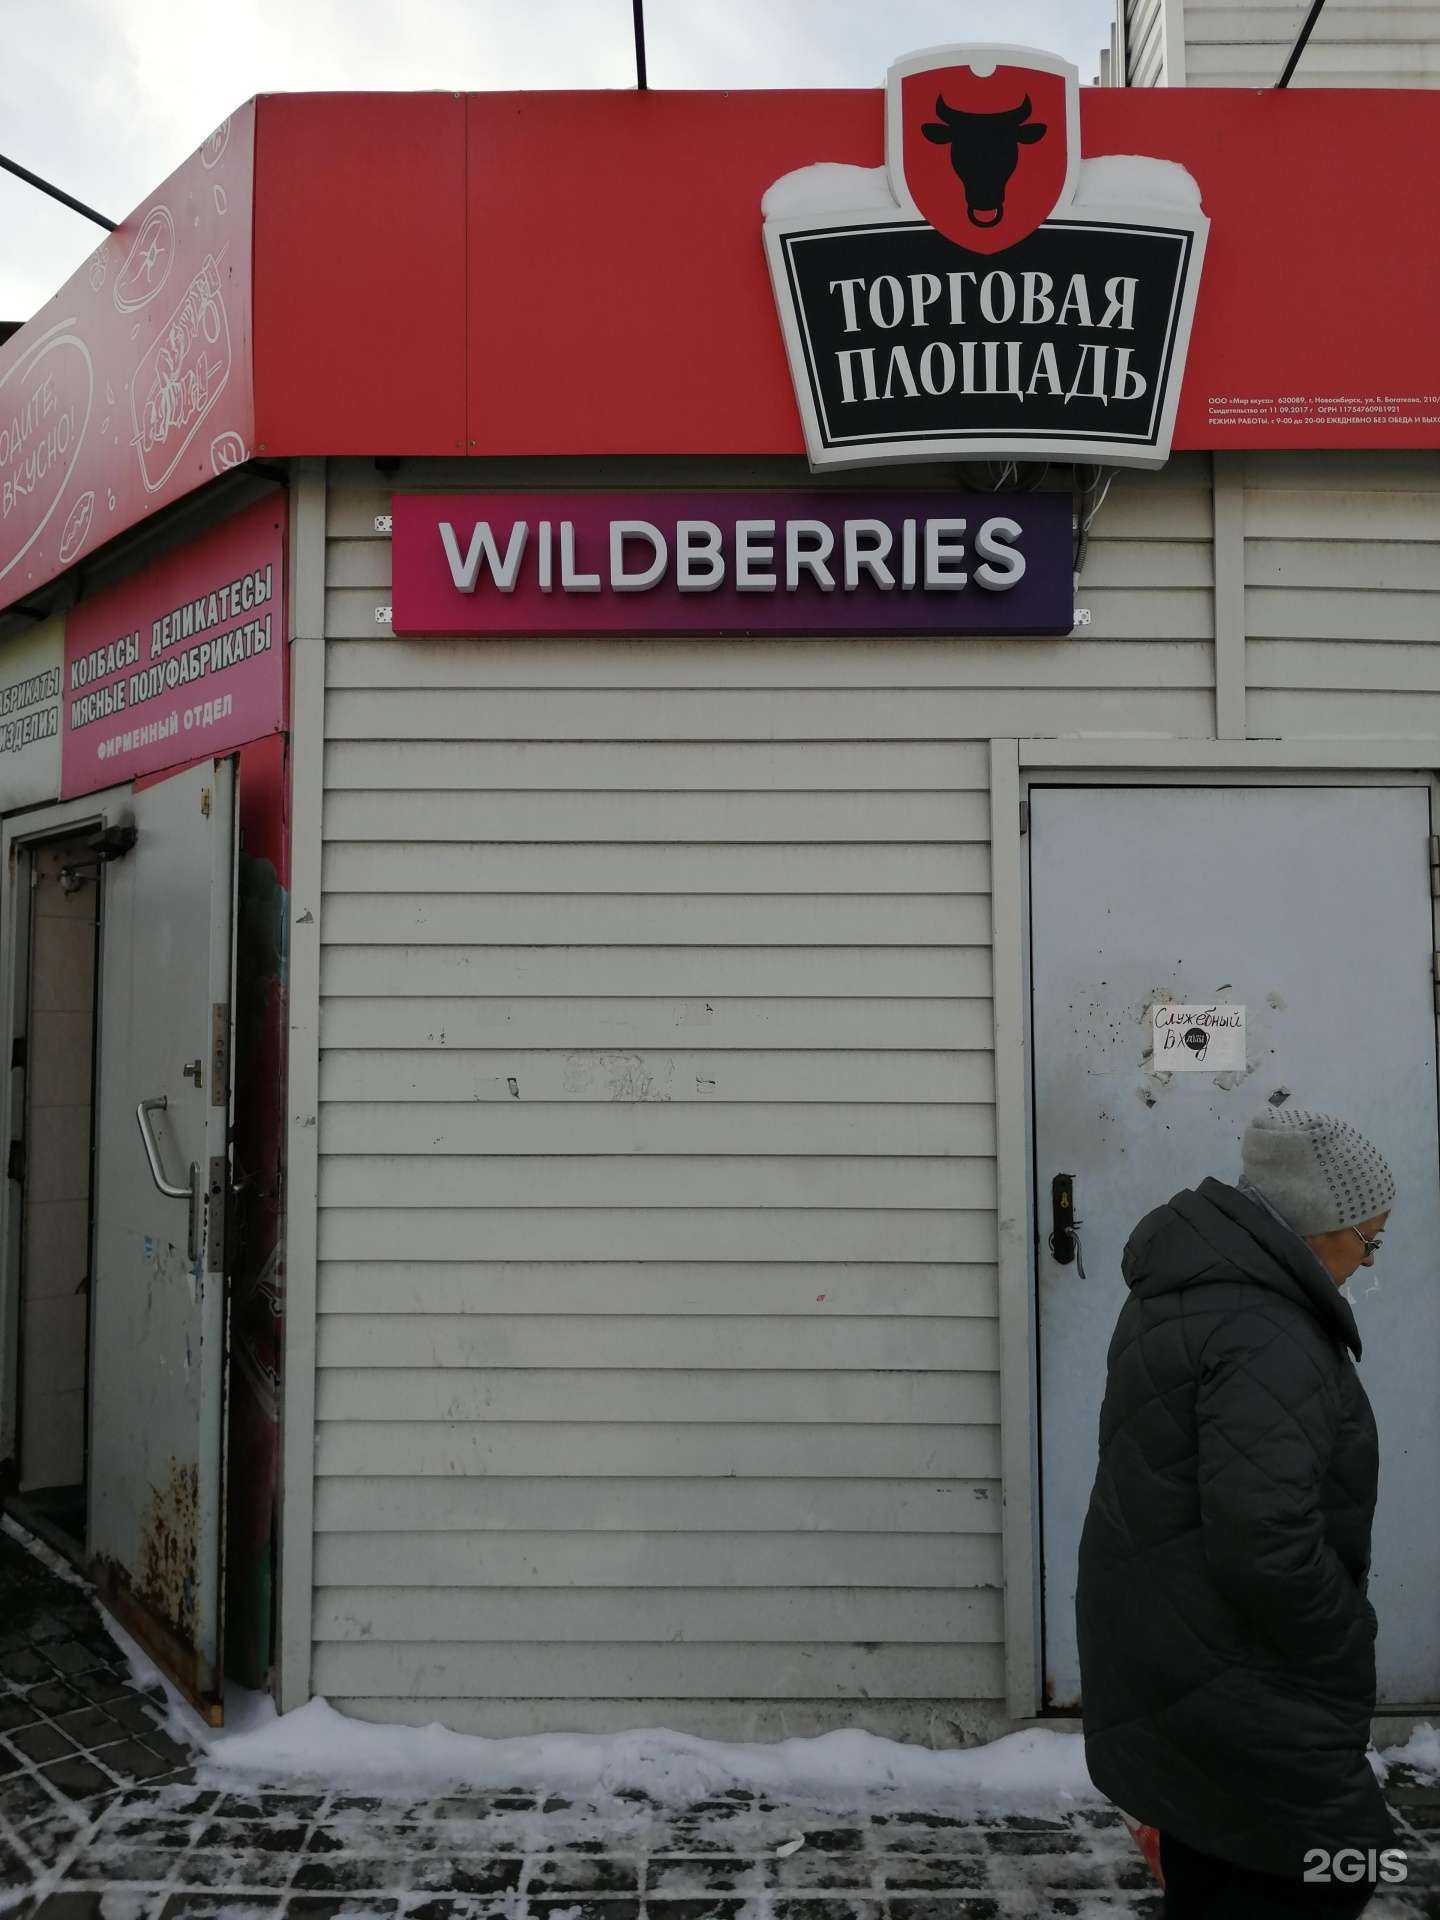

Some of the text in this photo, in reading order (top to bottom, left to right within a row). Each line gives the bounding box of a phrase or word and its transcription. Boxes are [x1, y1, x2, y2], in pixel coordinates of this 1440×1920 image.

[829, 269, 1140, 333] ТОРГОВАЯ
[833, 341, 1148, 407] ПЛОЩАДЬ
[1373, 416, 1386, 424] БЕЗ
[3, 405, 75, 519] ВКУСНО!
[437, 516, 1028, 593] WILDBERRIES
[71, 564, 272, 690] КОЛБАСЫ ДЕЛИКАТЕСЫ
[71, 614, 272, 730] МЯСНЫЕ ПОЛУФАБРИКАТЫ
[97, 694, 233, 760] ФИРМЕННЫЙ ОТДЕЛ
[1155, 1006, 1242, 1029] Служебный
